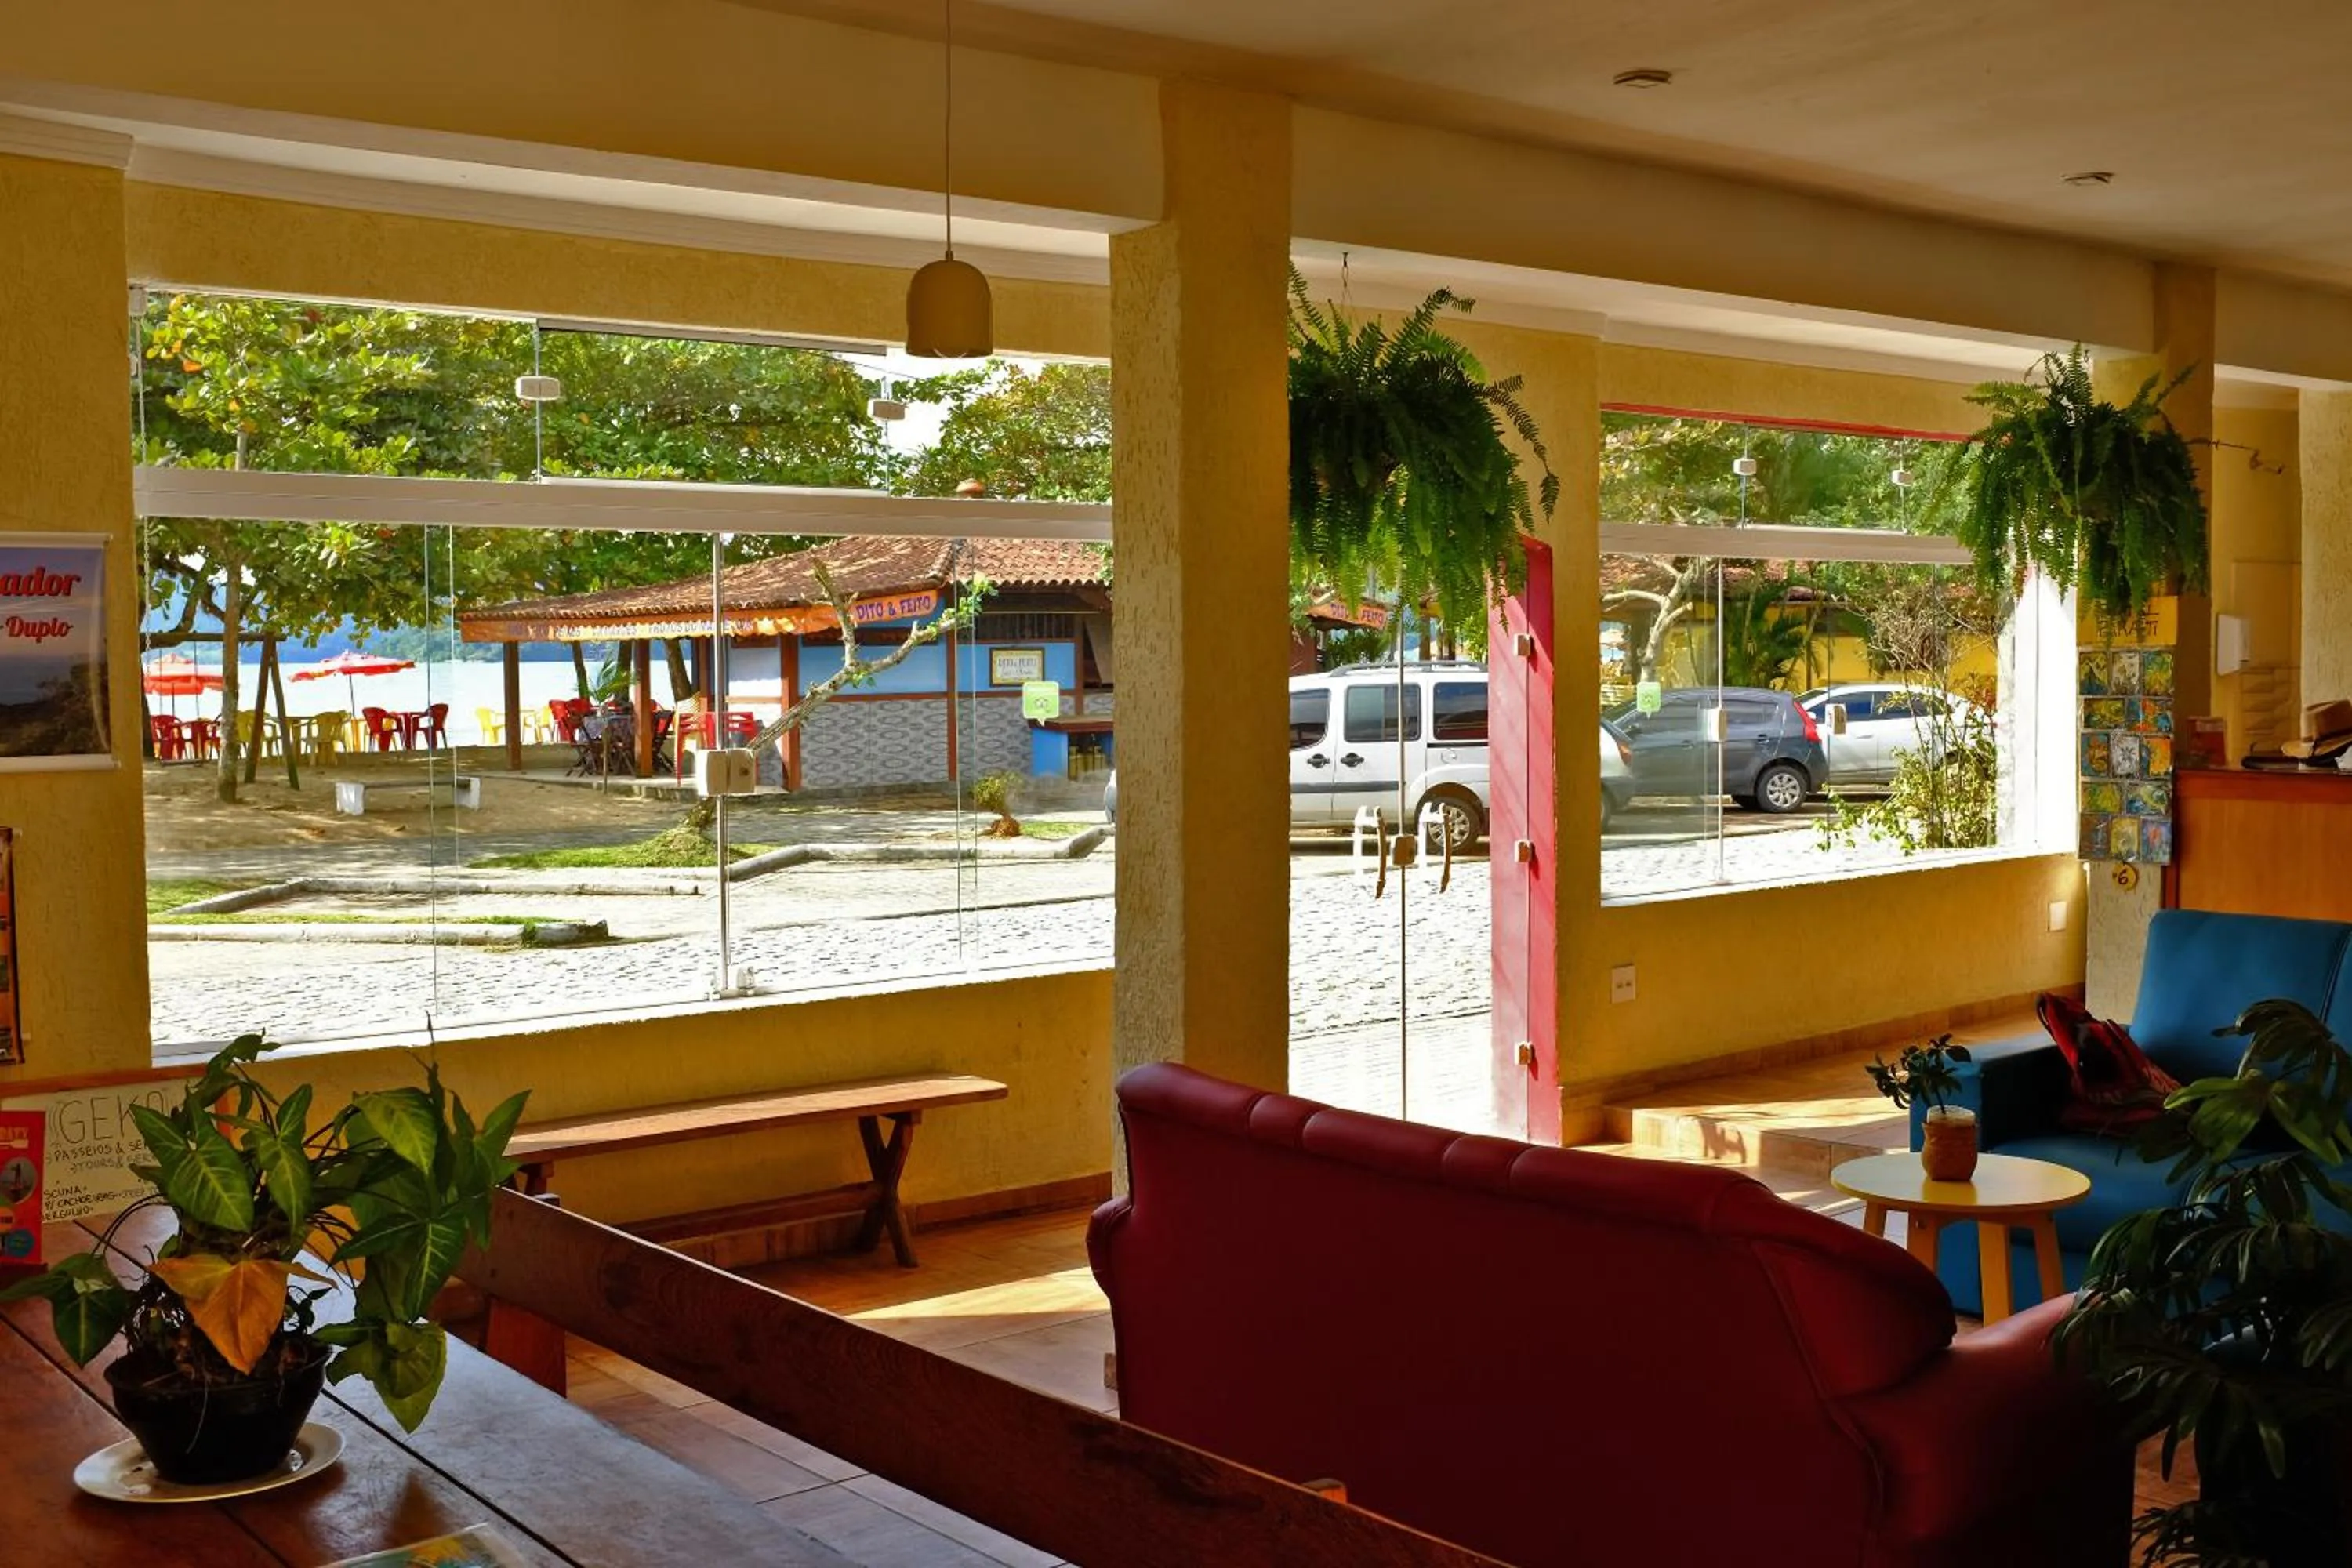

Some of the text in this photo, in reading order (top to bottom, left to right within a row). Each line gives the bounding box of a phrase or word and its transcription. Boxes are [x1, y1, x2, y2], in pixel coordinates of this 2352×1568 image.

[855, 595, 931, 619] DITO & FEITO
[1362, 609, 1384, 625] FEITO
[53, 1144, 112, 1163] PASSEIOS
